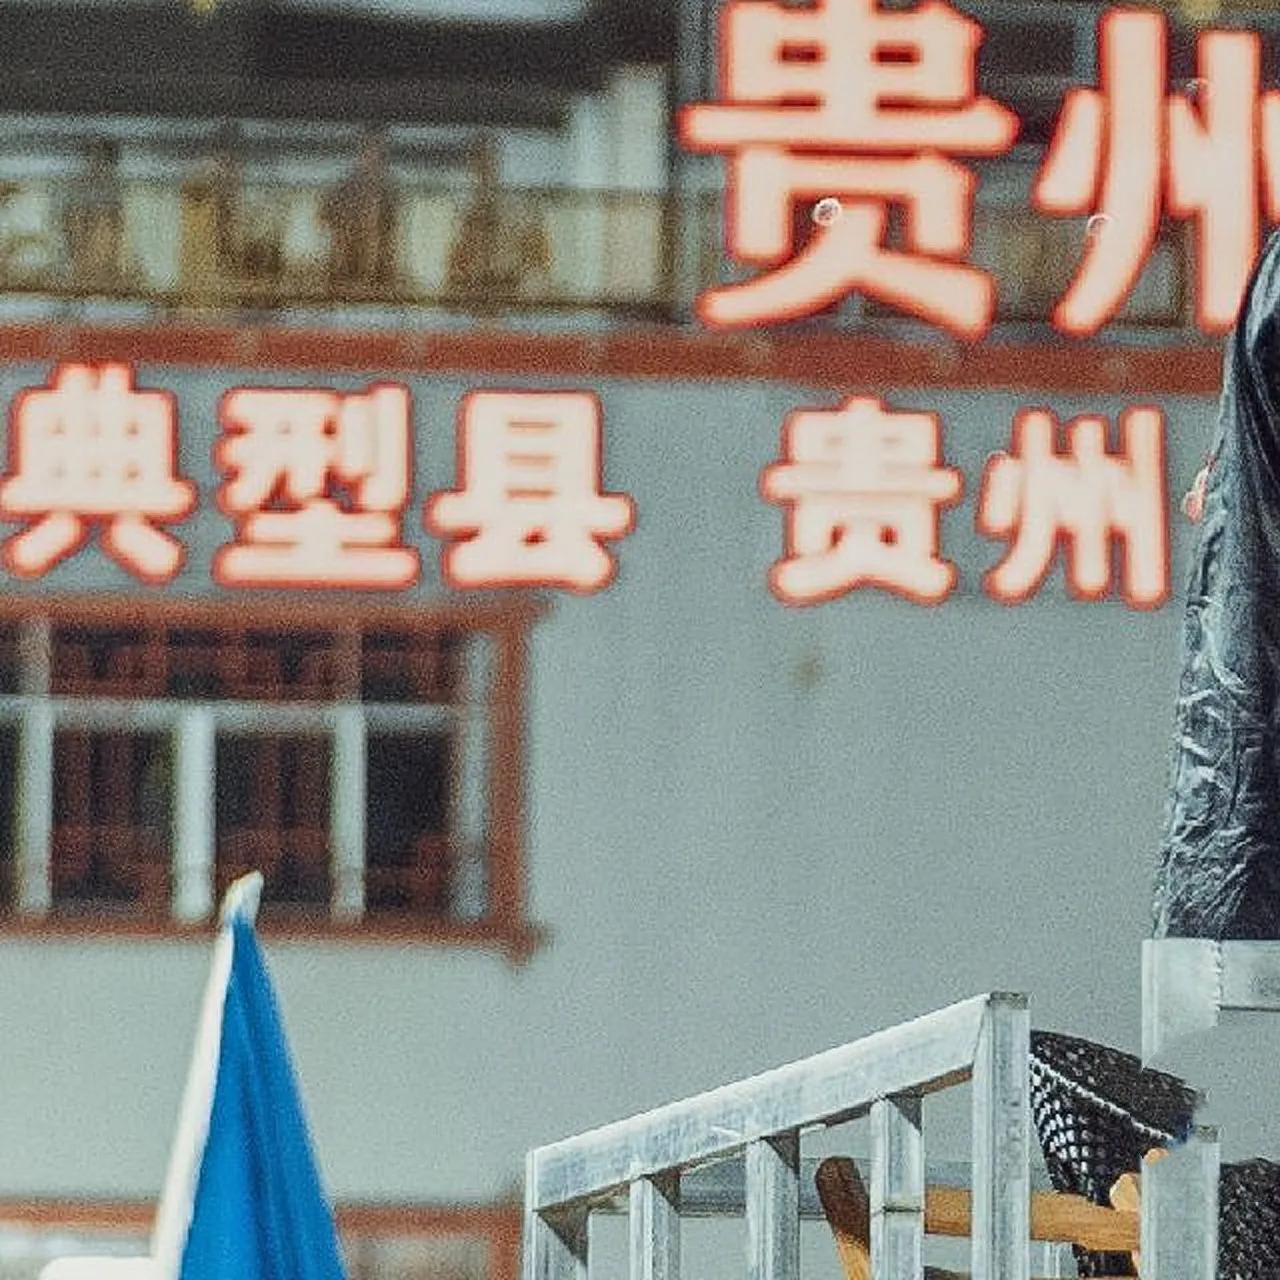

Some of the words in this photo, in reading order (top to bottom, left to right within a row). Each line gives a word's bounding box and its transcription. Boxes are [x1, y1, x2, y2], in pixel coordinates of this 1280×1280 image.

[0, 360, 636, 593] 典型县
[761, 395, 1213, 612] 贵州
